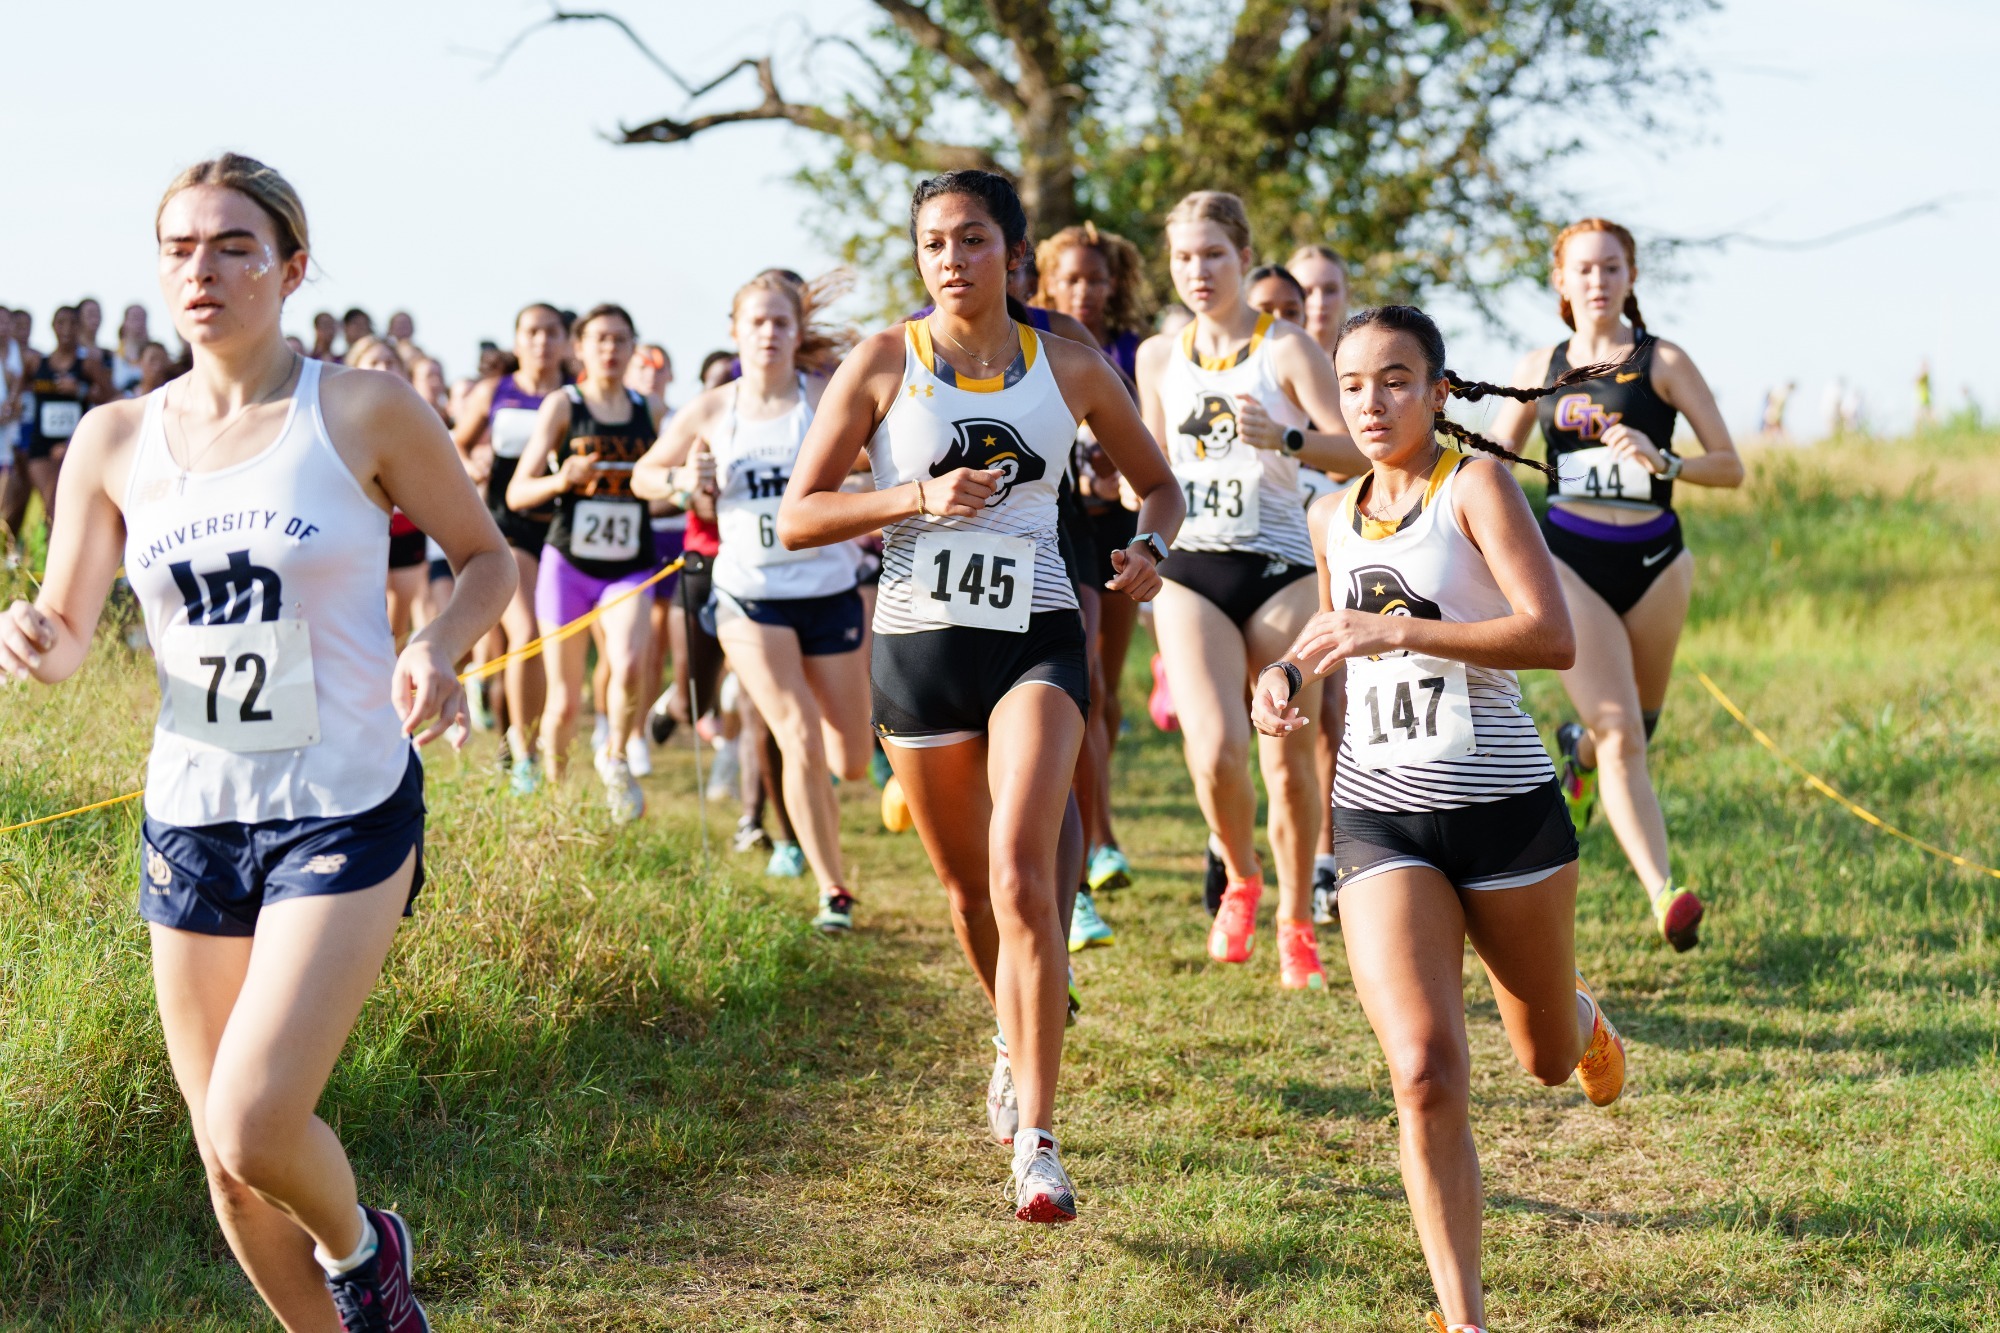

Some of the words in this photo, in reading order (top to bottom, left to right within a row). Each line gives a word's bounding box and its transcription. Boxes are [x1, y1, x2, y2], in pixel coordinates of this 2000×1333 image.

[569, 434, 655, 460] TEXA
[1185, 480, 1243, 518] 143
[1586, 463, 1624, 499] 44
[137, 510, 277, 569] UNIVERSITY
[285, 516, 320, 540] OF
[584, 513, 631, 546] 243
[930, 549, 1016, 609] 145
[200, 653, 273, 723] 72
[1365, 676, 1445, 745] 147
